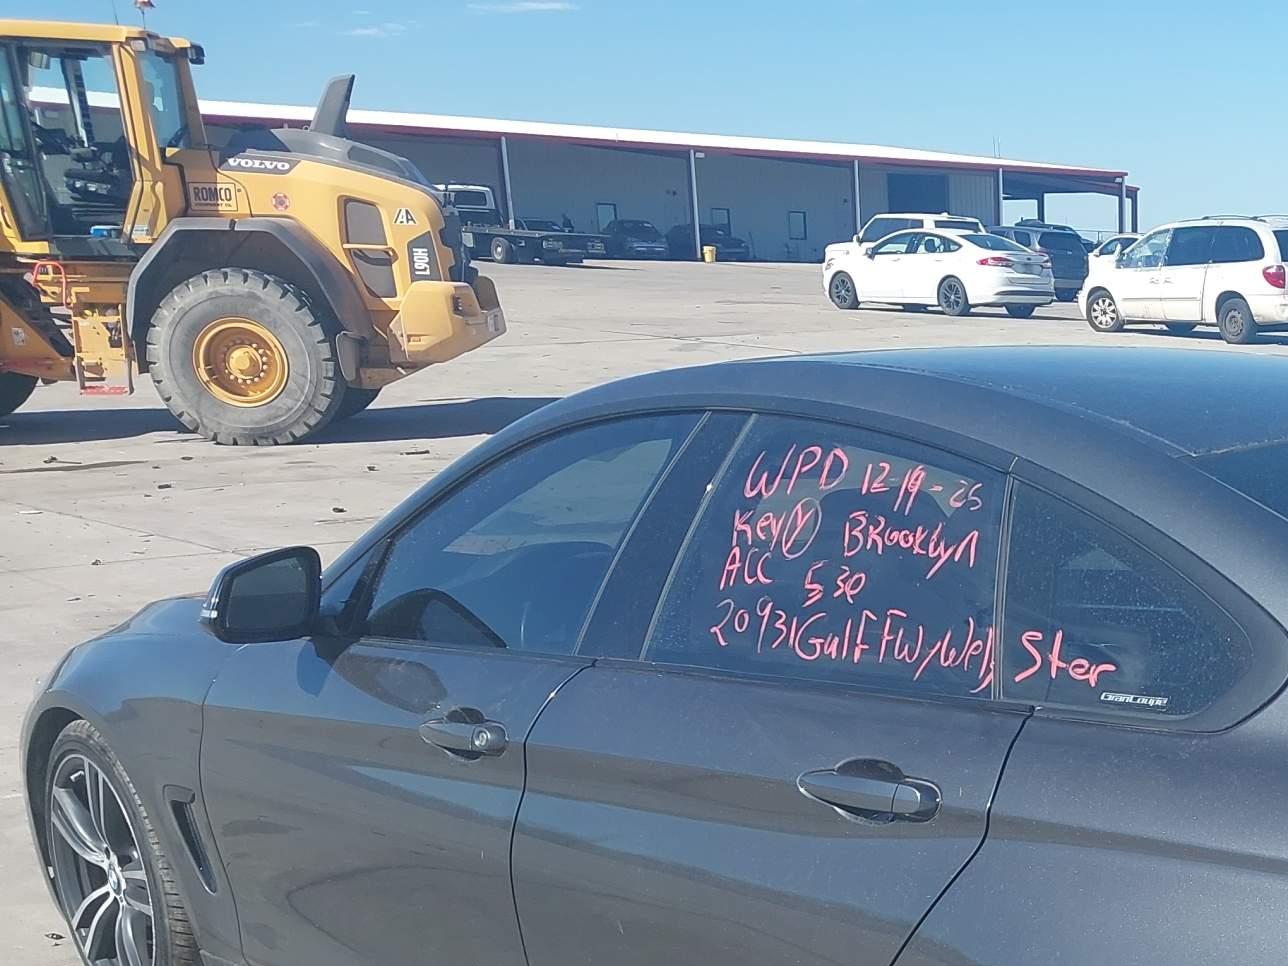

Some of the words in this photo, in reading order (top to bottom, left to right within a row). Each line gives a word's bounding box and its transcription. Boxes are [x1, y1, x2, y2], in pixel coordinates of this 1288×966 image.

[227, 157, 290, 170] VOLVO
[193, 186, 232, 202] ROMCO
[412, 247, 431, 276] L90H
[743, 443, 849, 498] WPD
[719, 546, 773, 591] ACC
